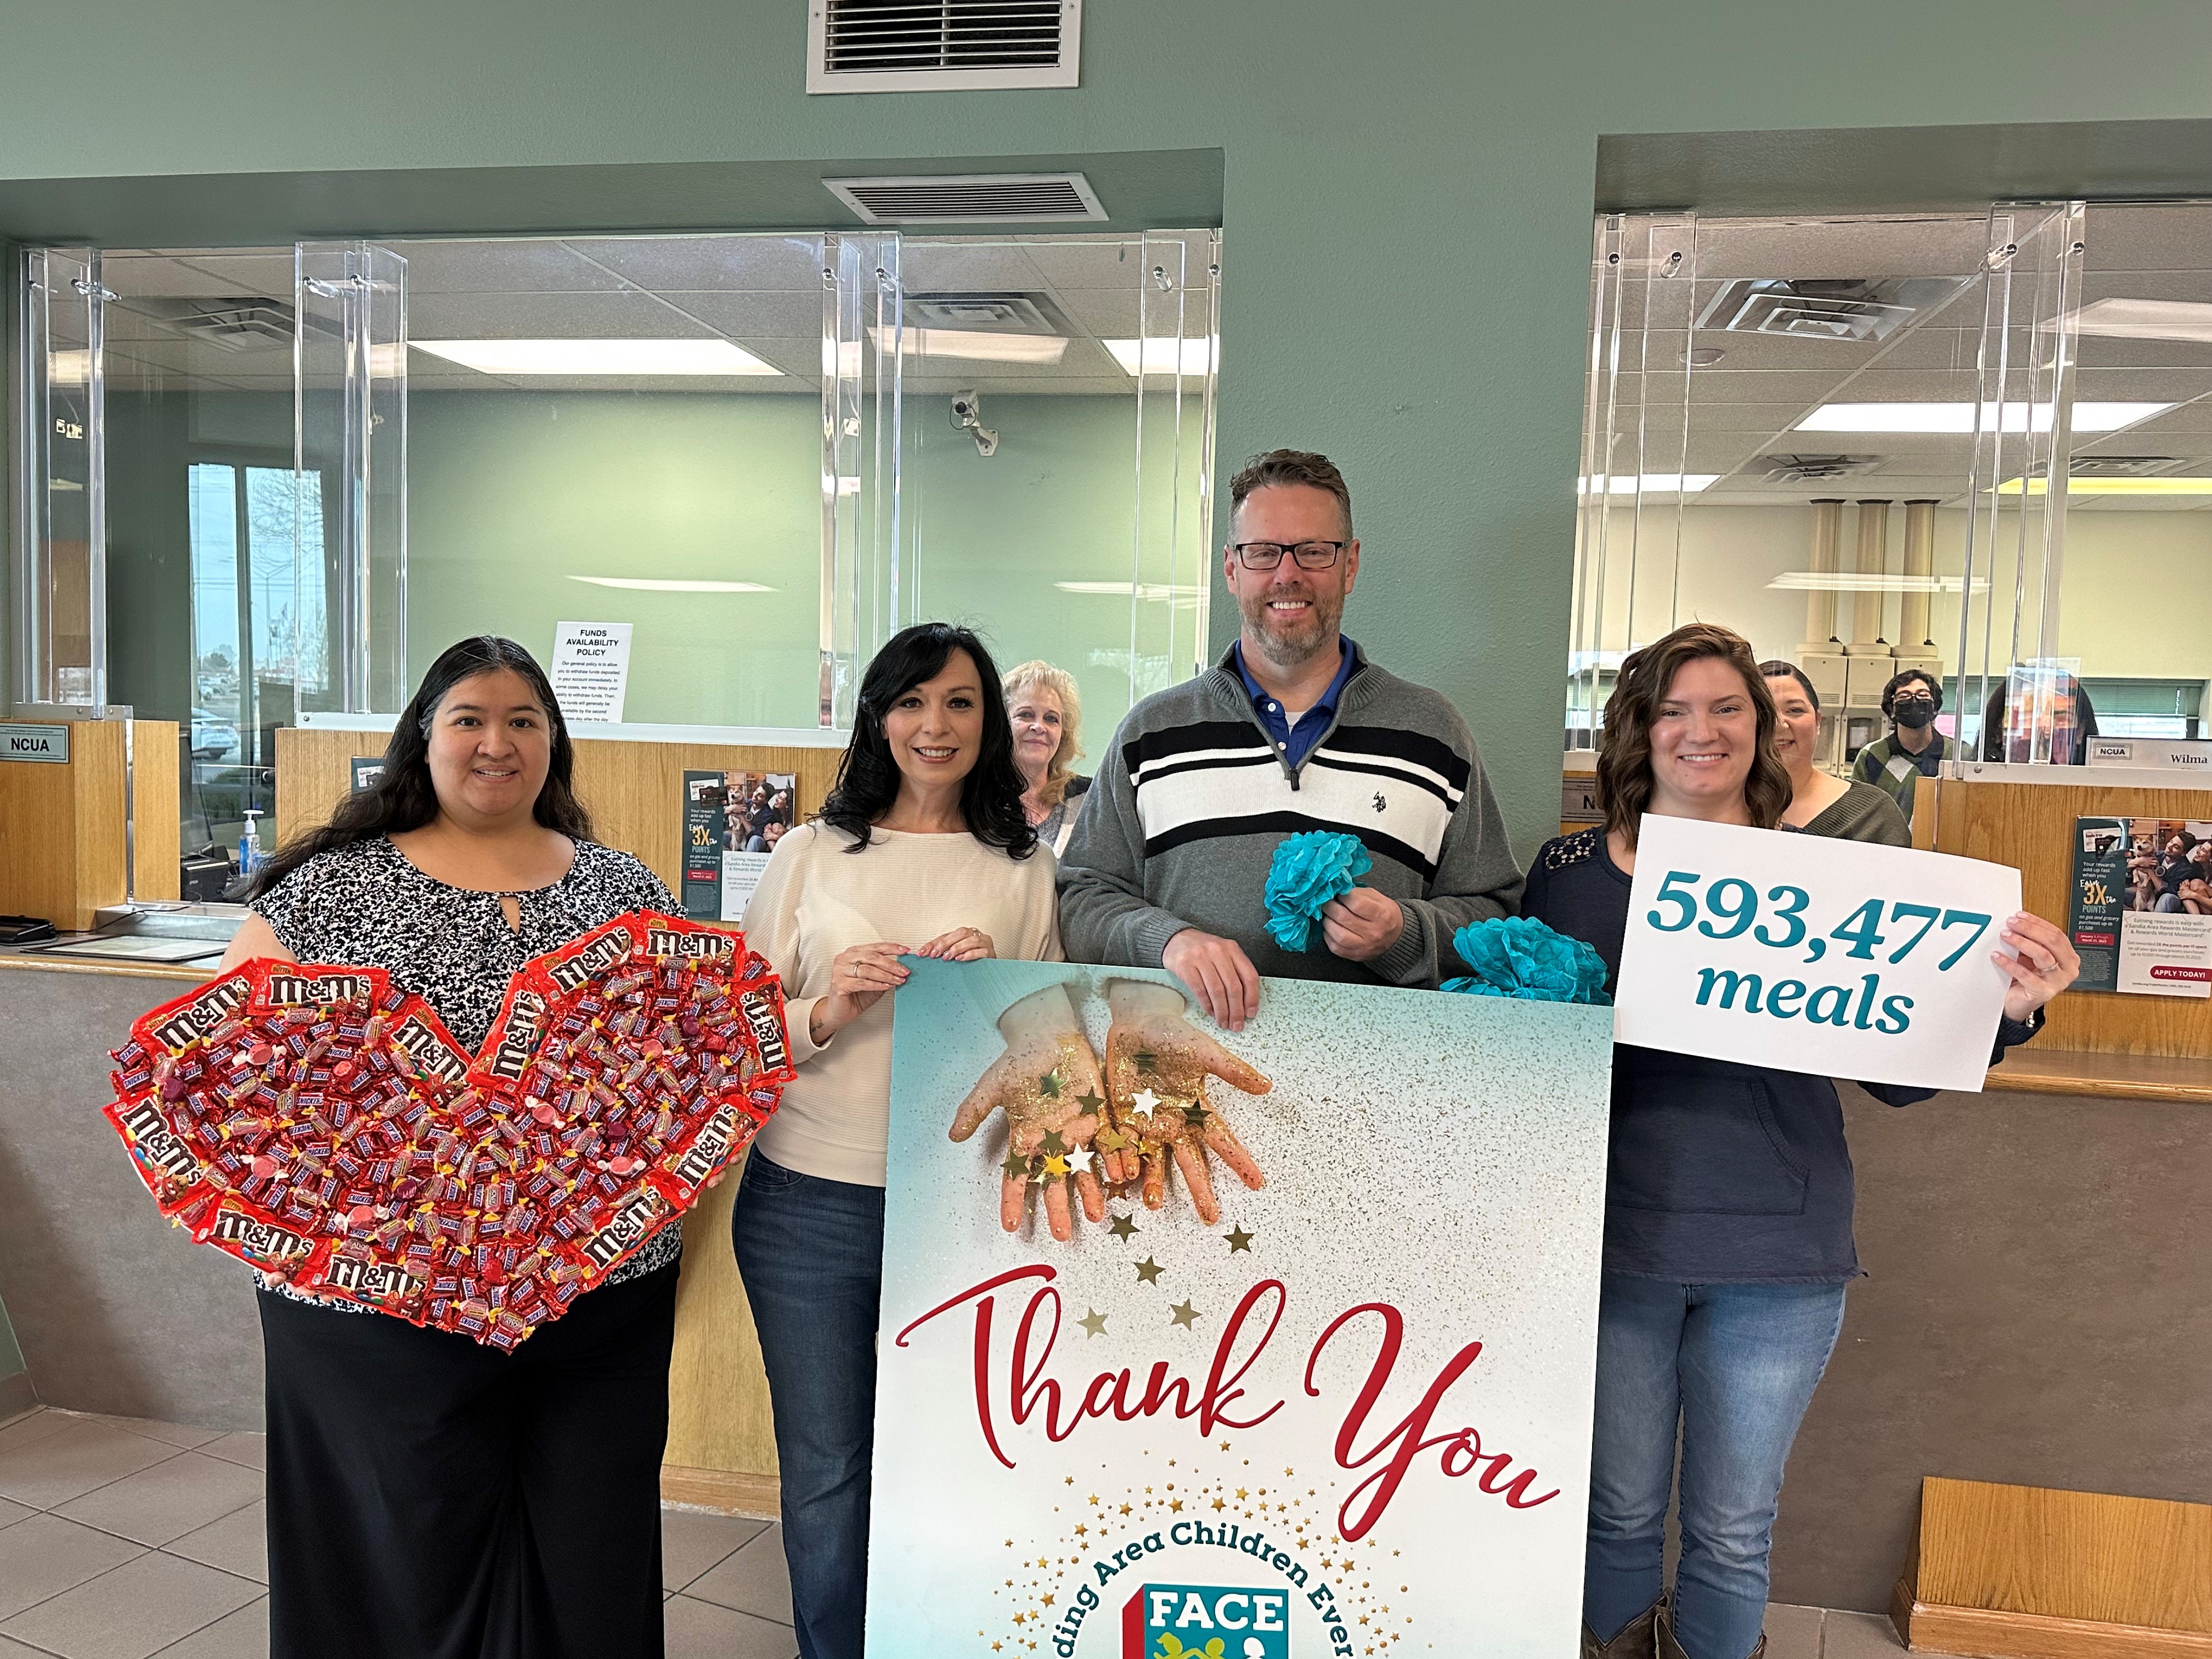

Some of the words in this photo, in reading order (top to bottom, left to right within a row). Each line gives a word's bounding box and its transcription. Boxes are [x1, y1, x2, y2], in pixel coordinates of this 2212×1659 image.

[11, 737, 49, 752] NCUA
[2171, 754, 2207, 764] Wilma
[692, 828, 710, 846] 3X
[2083, 884, 2107, 905] 3X
[2083, 905, 2107, 913] POINTS
[1647, 871, 1991, 972] 593,477
[647, 928, 735, 958] m&m's
[269, 974, 372, 1005] m&m's
[1696, 967, 1915, 1035] meals
[211, 1209, 315, 1261] m&m's
[895, 1263, 1286, 1469] Thank
[1305, 1302, 1561, 1542] You
[1093, 1532, 1164, 1587] Area
[1171, 1521, 1308, 1588] Children
[1149, 1591, 1284, 1632] FACE
